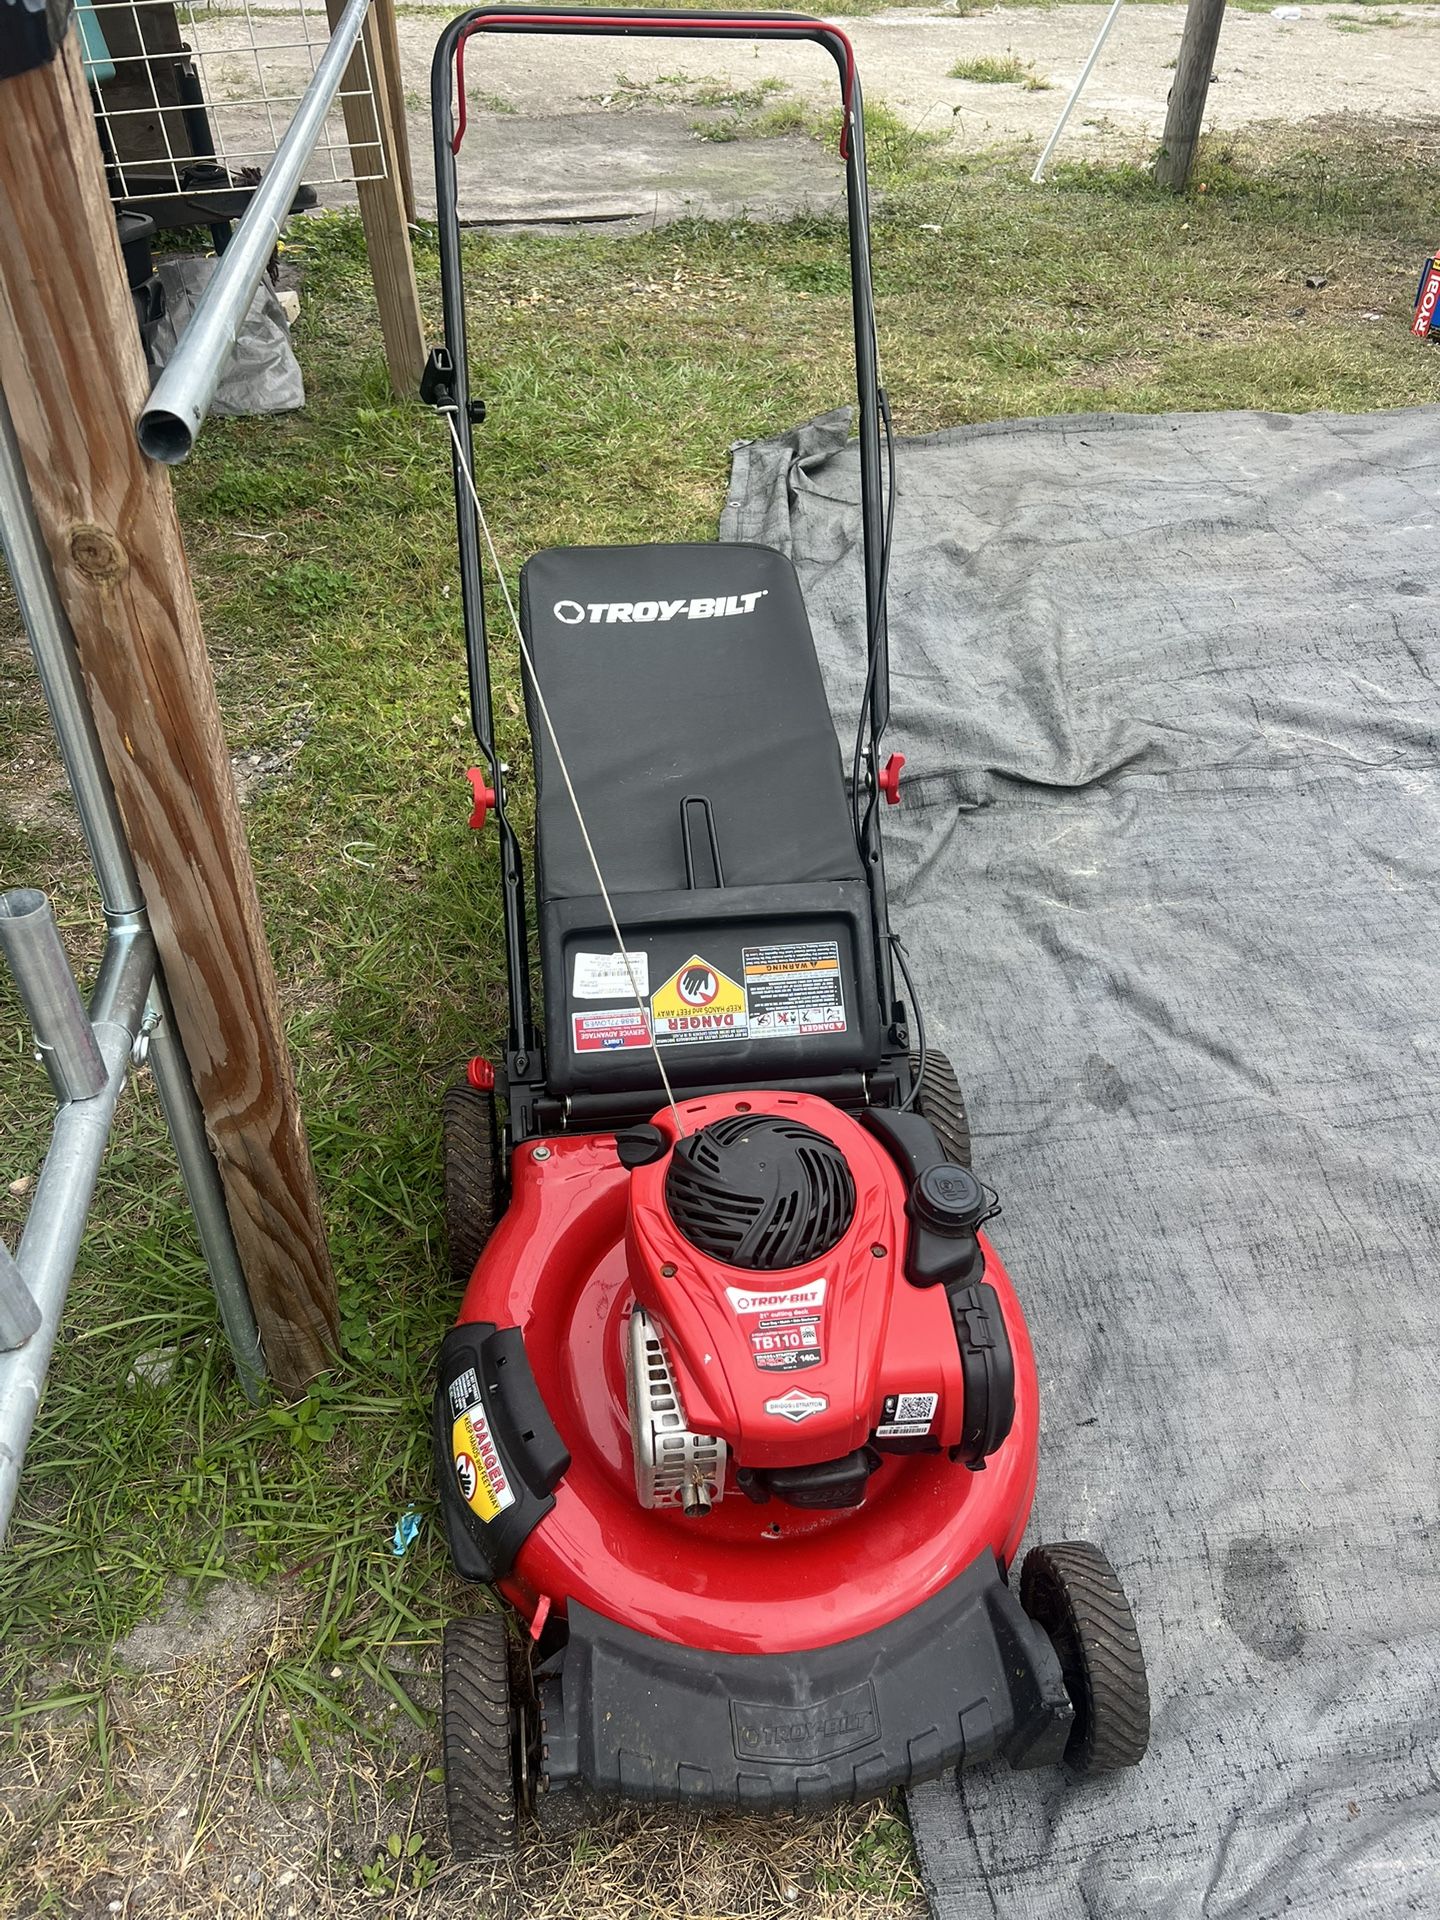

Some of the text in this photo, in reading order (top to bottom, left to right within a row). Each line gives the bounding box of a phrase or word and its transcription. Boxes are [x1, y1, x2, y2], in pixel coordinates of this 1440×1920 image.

[1415, 275, 1440, 331] RYOBI
[587, 590, 762, 623] TROY-BILT
[766, 962, 807, 971] WARNING
[668, 1014, 734, 1030] DANGER
[801, 1023, 834, 1032] DANGER
[581, 1029, 645, 1039] SERVICE ADVANTAGE
[751, 1292, 818, 1306] TROY-BILT
[752, 1334, 800, 1350] TB110
[463, 1417, 500, 1510] KEEP HANDS and FEET AWAY
[472, 1417, 506, 1495] DANGER
[763, 1711, 868, 1745] TROY-BILT
